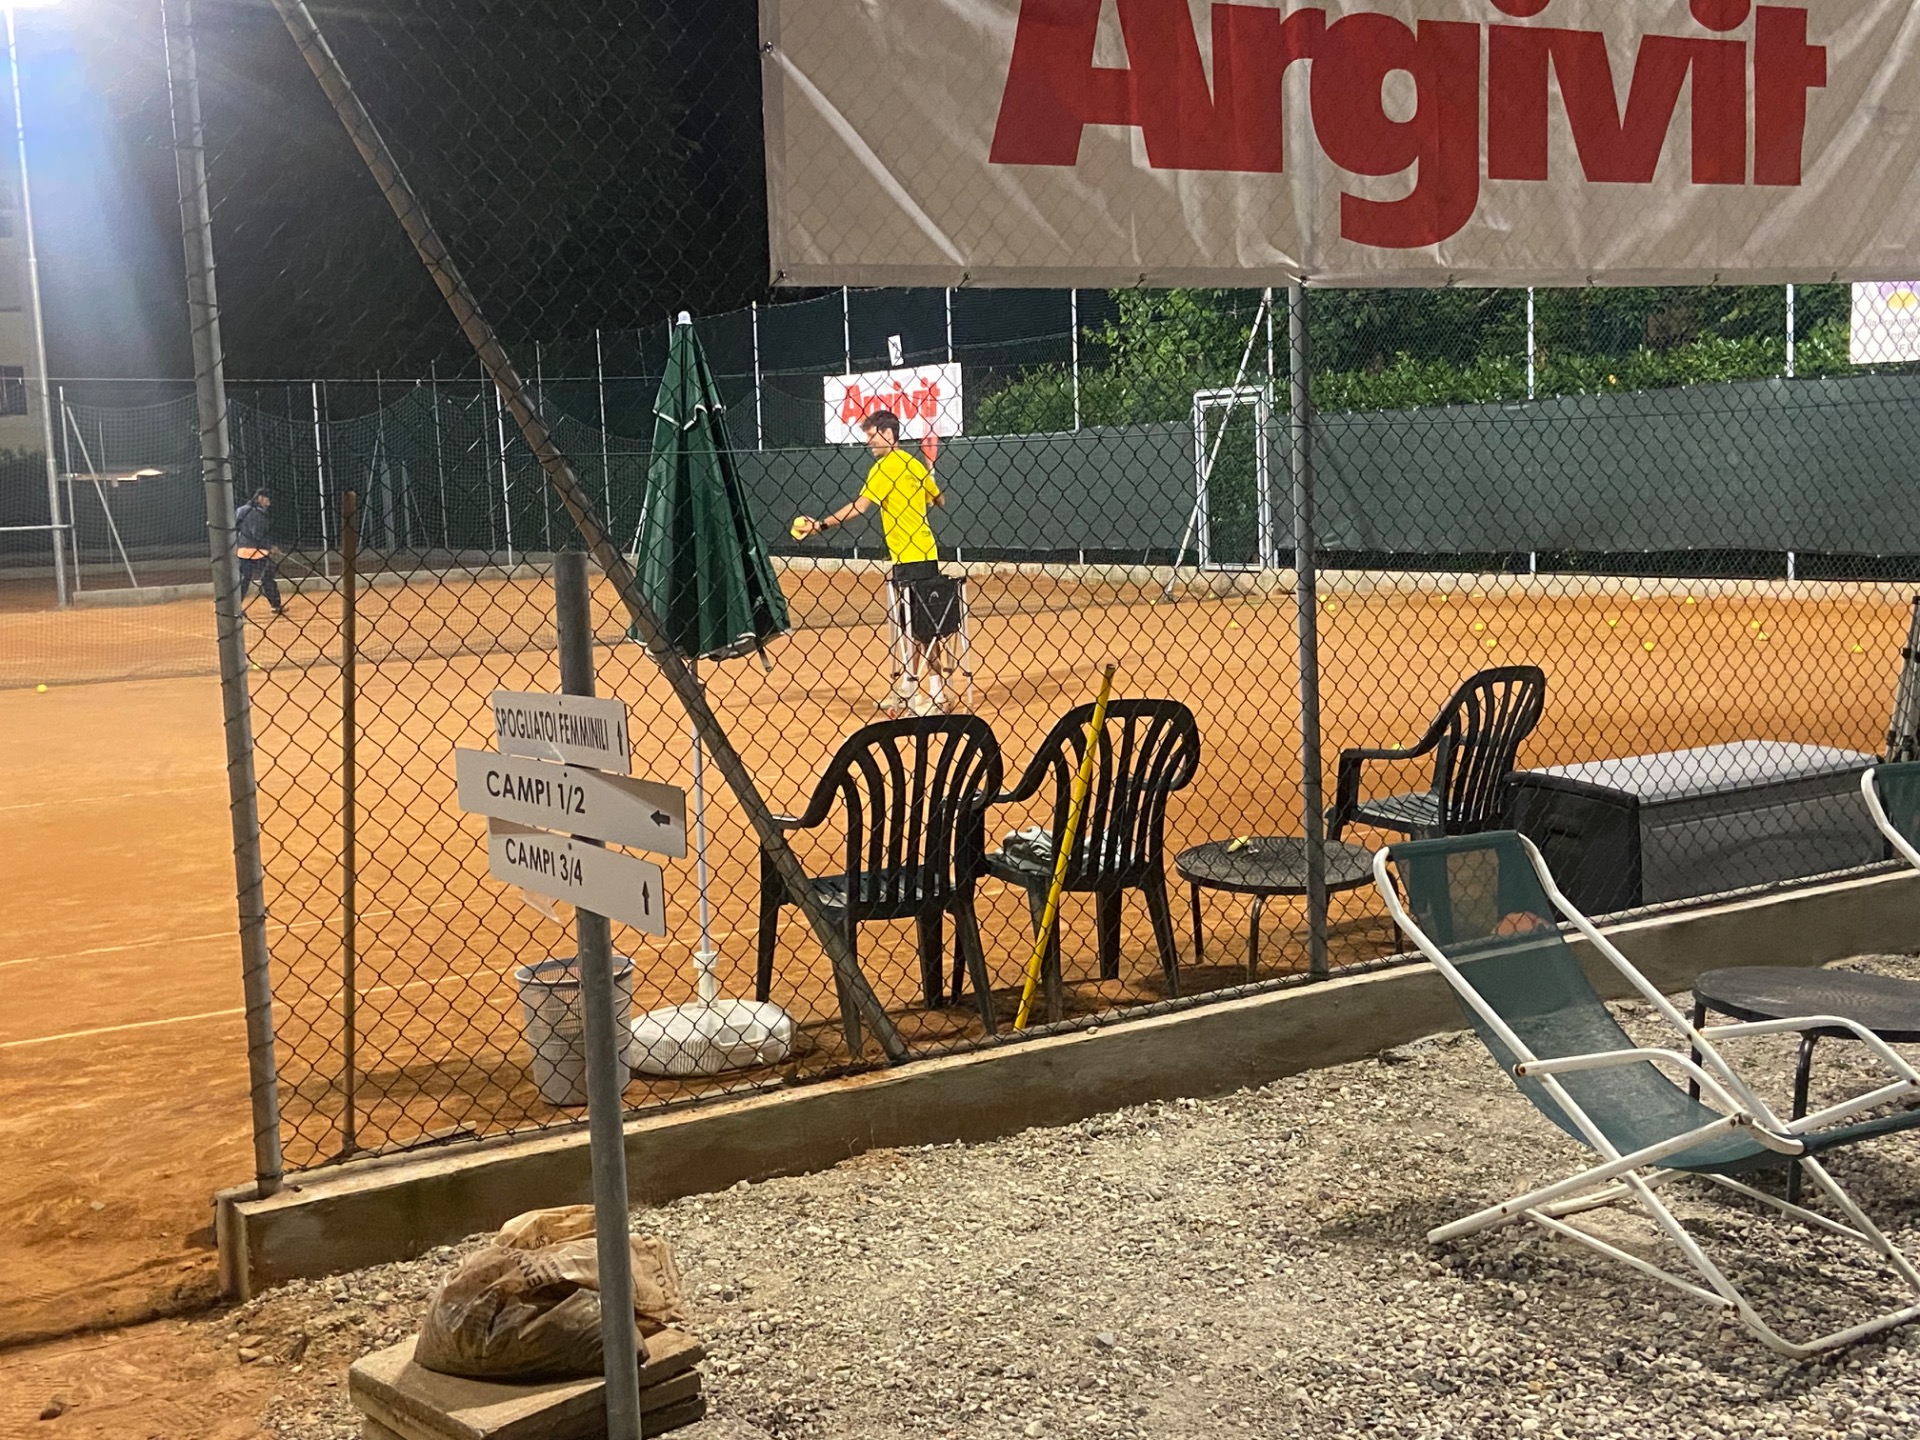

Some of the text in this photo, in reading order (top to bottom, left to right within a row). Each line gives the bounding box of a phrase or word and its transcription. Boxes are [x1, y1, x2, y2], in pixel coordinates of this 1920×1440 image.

[989, 0, 1828, 249] Argivit
[495, 707, 610, 751] SPOGLIATOI FEMMINILI
[486, 770, 586, 815] CAMPI 1/2
[505, 838, 583, 886] CAMPI 3/4
